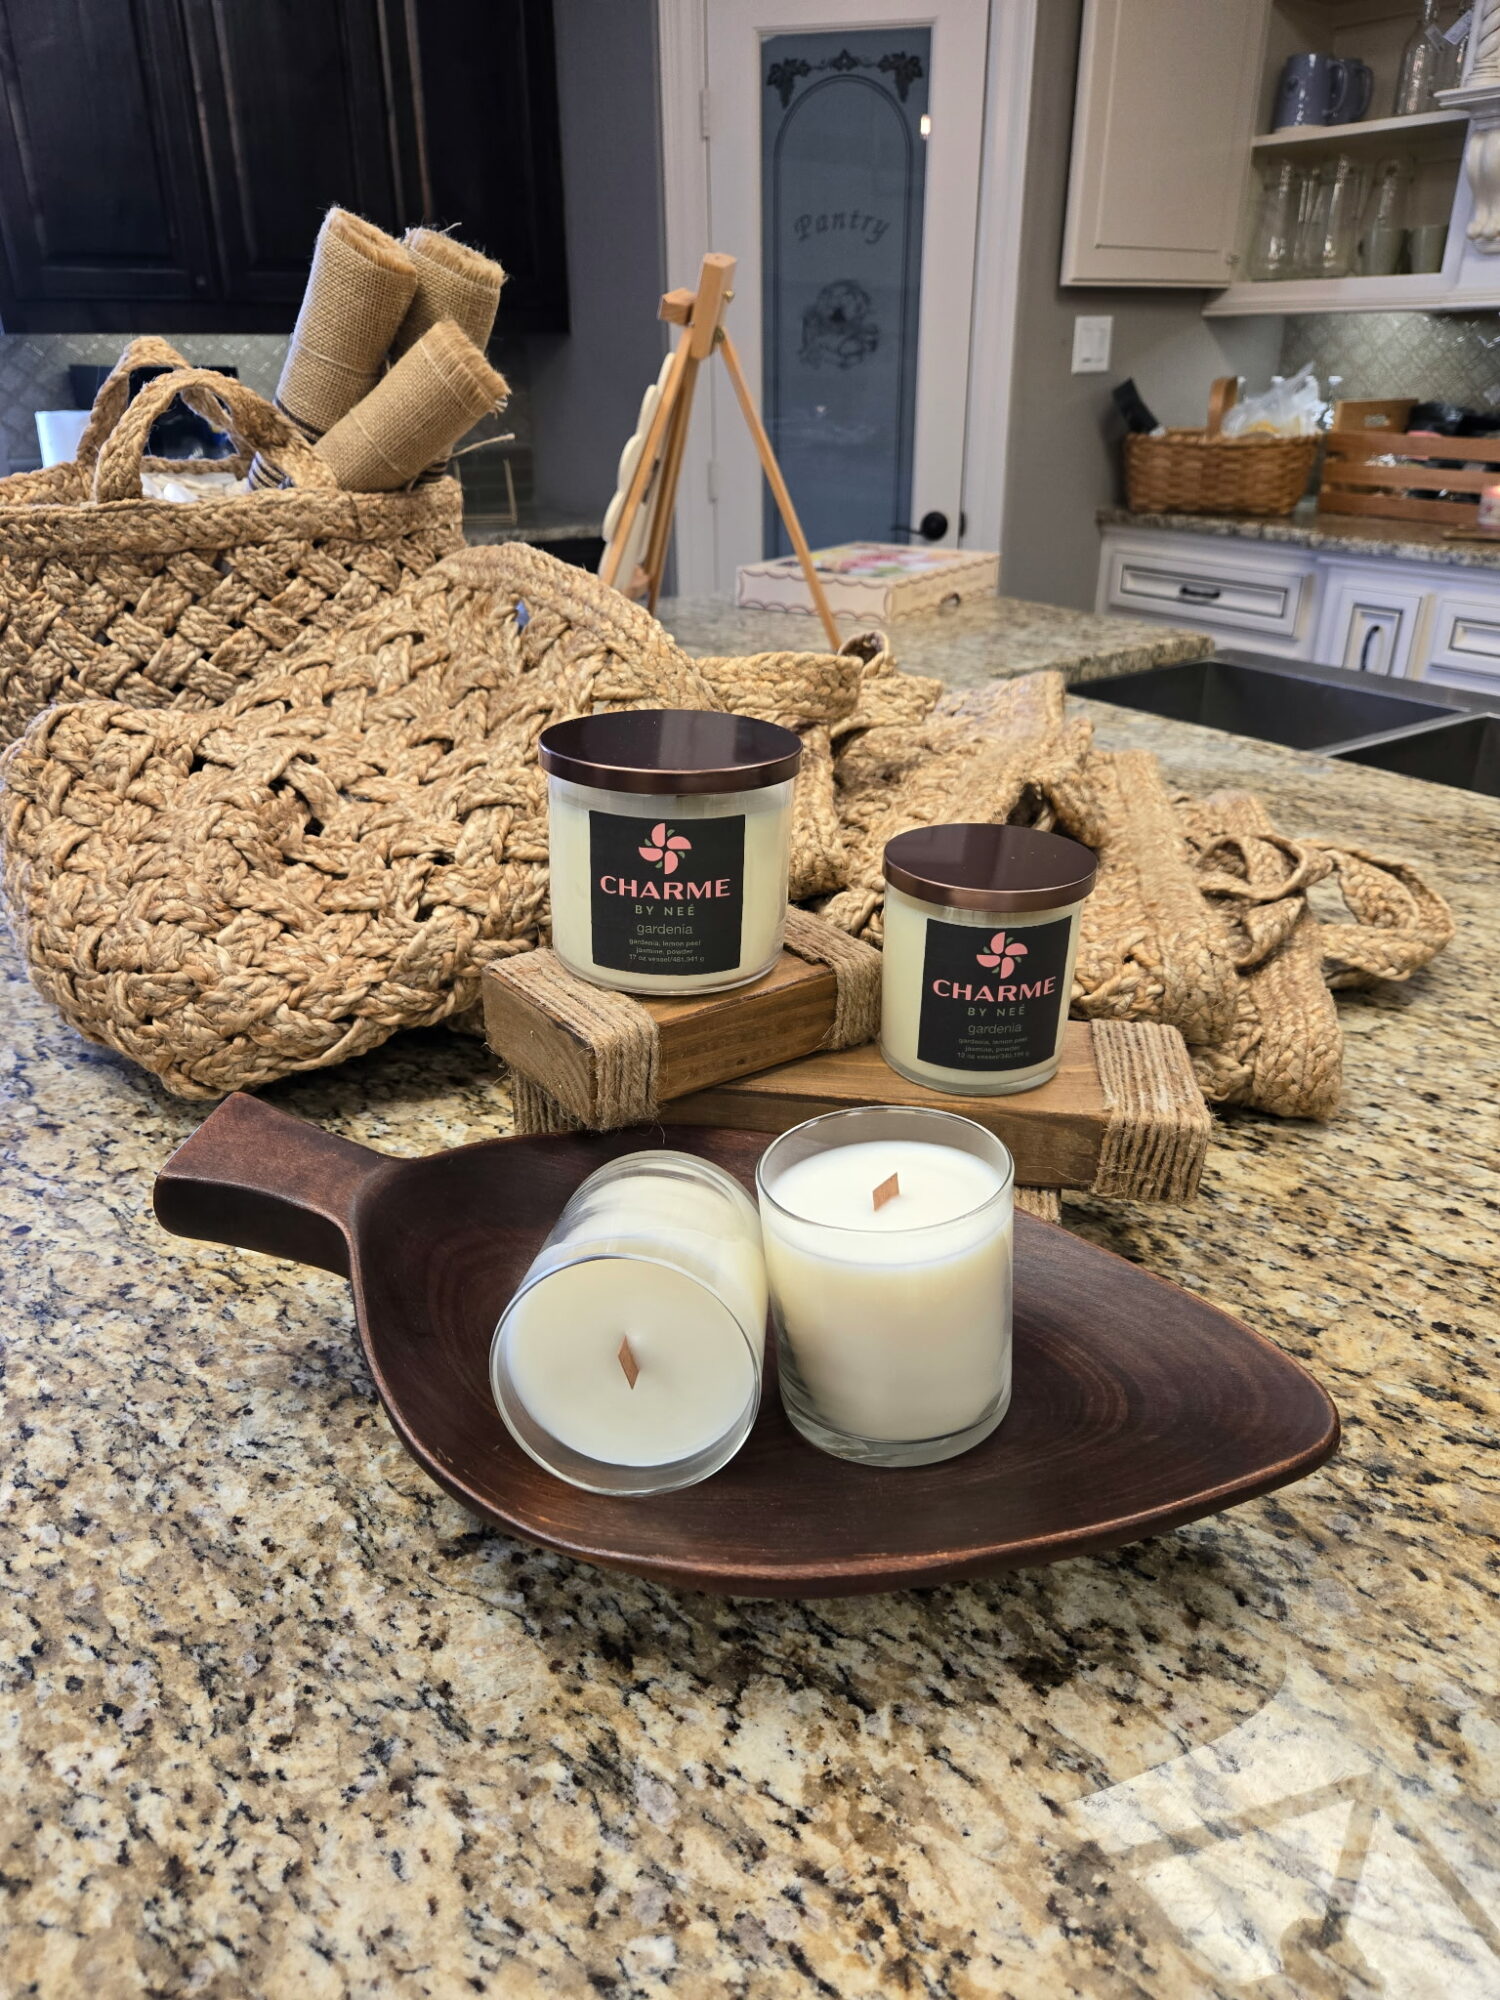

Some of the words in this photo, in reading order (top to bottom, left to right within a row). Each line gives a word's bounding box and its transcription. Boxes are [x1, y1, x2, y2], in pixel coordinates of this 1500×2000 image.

[793, 209, 891, 244] Pantry
[600, 875, 731, 900] CHARME
[635, 904, 655, 916] BY
[664, 903, 695, 916] NEÉ
[637, 923, 693, 936] gardenia
[932, 976, 1056, 1002] CHARME
[967, 1007, 987, 1016] BY
[996, 1004, 1025, 1016] NEÉ
[968, 1022, 1022, 1036] gardenia
